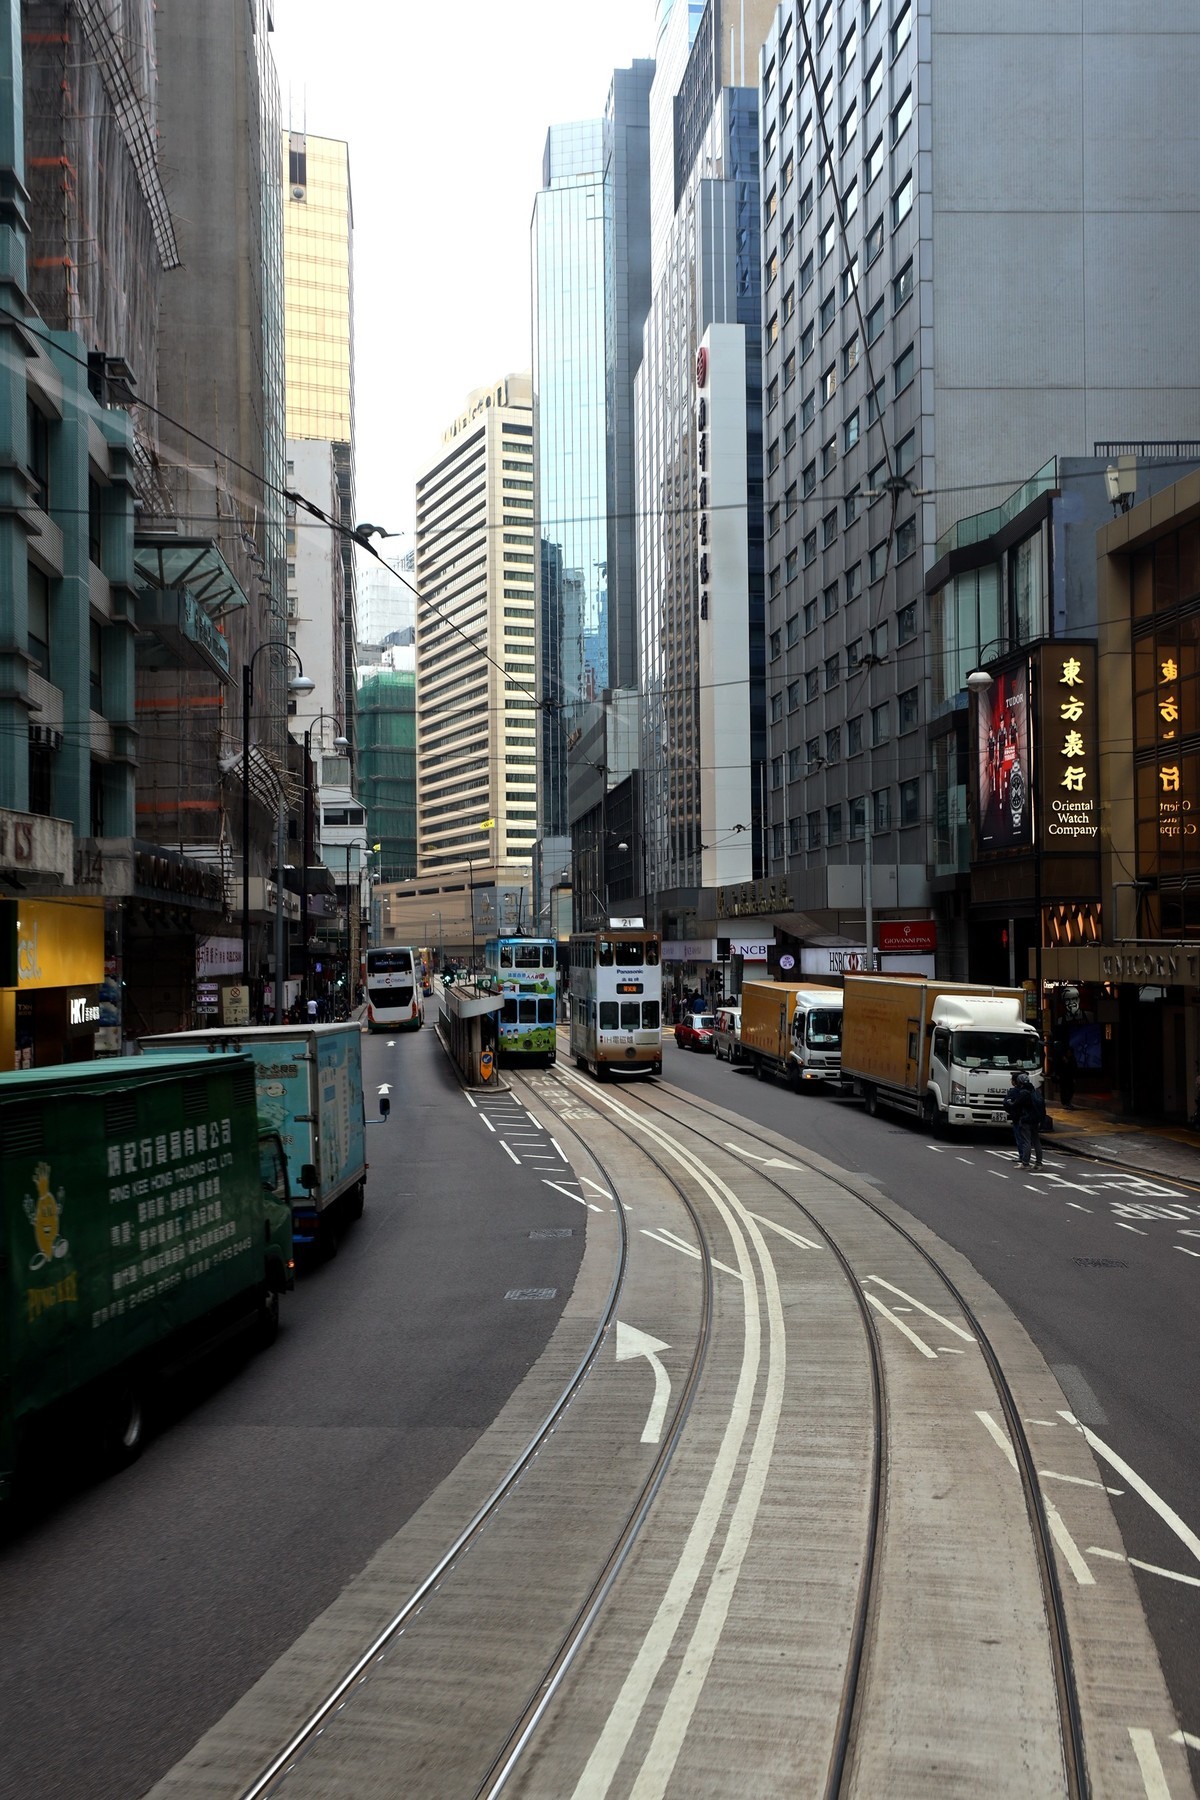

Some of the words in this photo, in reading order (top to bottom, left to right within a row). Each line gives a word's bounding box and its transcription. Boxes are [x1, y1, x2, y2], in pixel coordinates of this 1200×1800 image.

[1005, 693, 1024, 708] TUDOR
[1059, 657, 1087, 792] 東方表行
[1052, 799, 1093, 811] Oriental
[1057, 812, 1089, 823] Watch
[1048, 823, 1098, 837] Company
[77, 850, 103, 876] 114
[622, 919, 632, 927] 21
[740, 946, 766, 955] NCB
[829, 952, 848, 971] HSBC
[1103, 954, 1178, 976] UNICORN
[70, 997, 87, 1025] HKT
[108, 1185, 132, 1205] PING
[131, 1178, 149, 1197] KEE
[150, 1170, 173, 1192] HONG
[174, 1162, 207, 1183] TRADING
